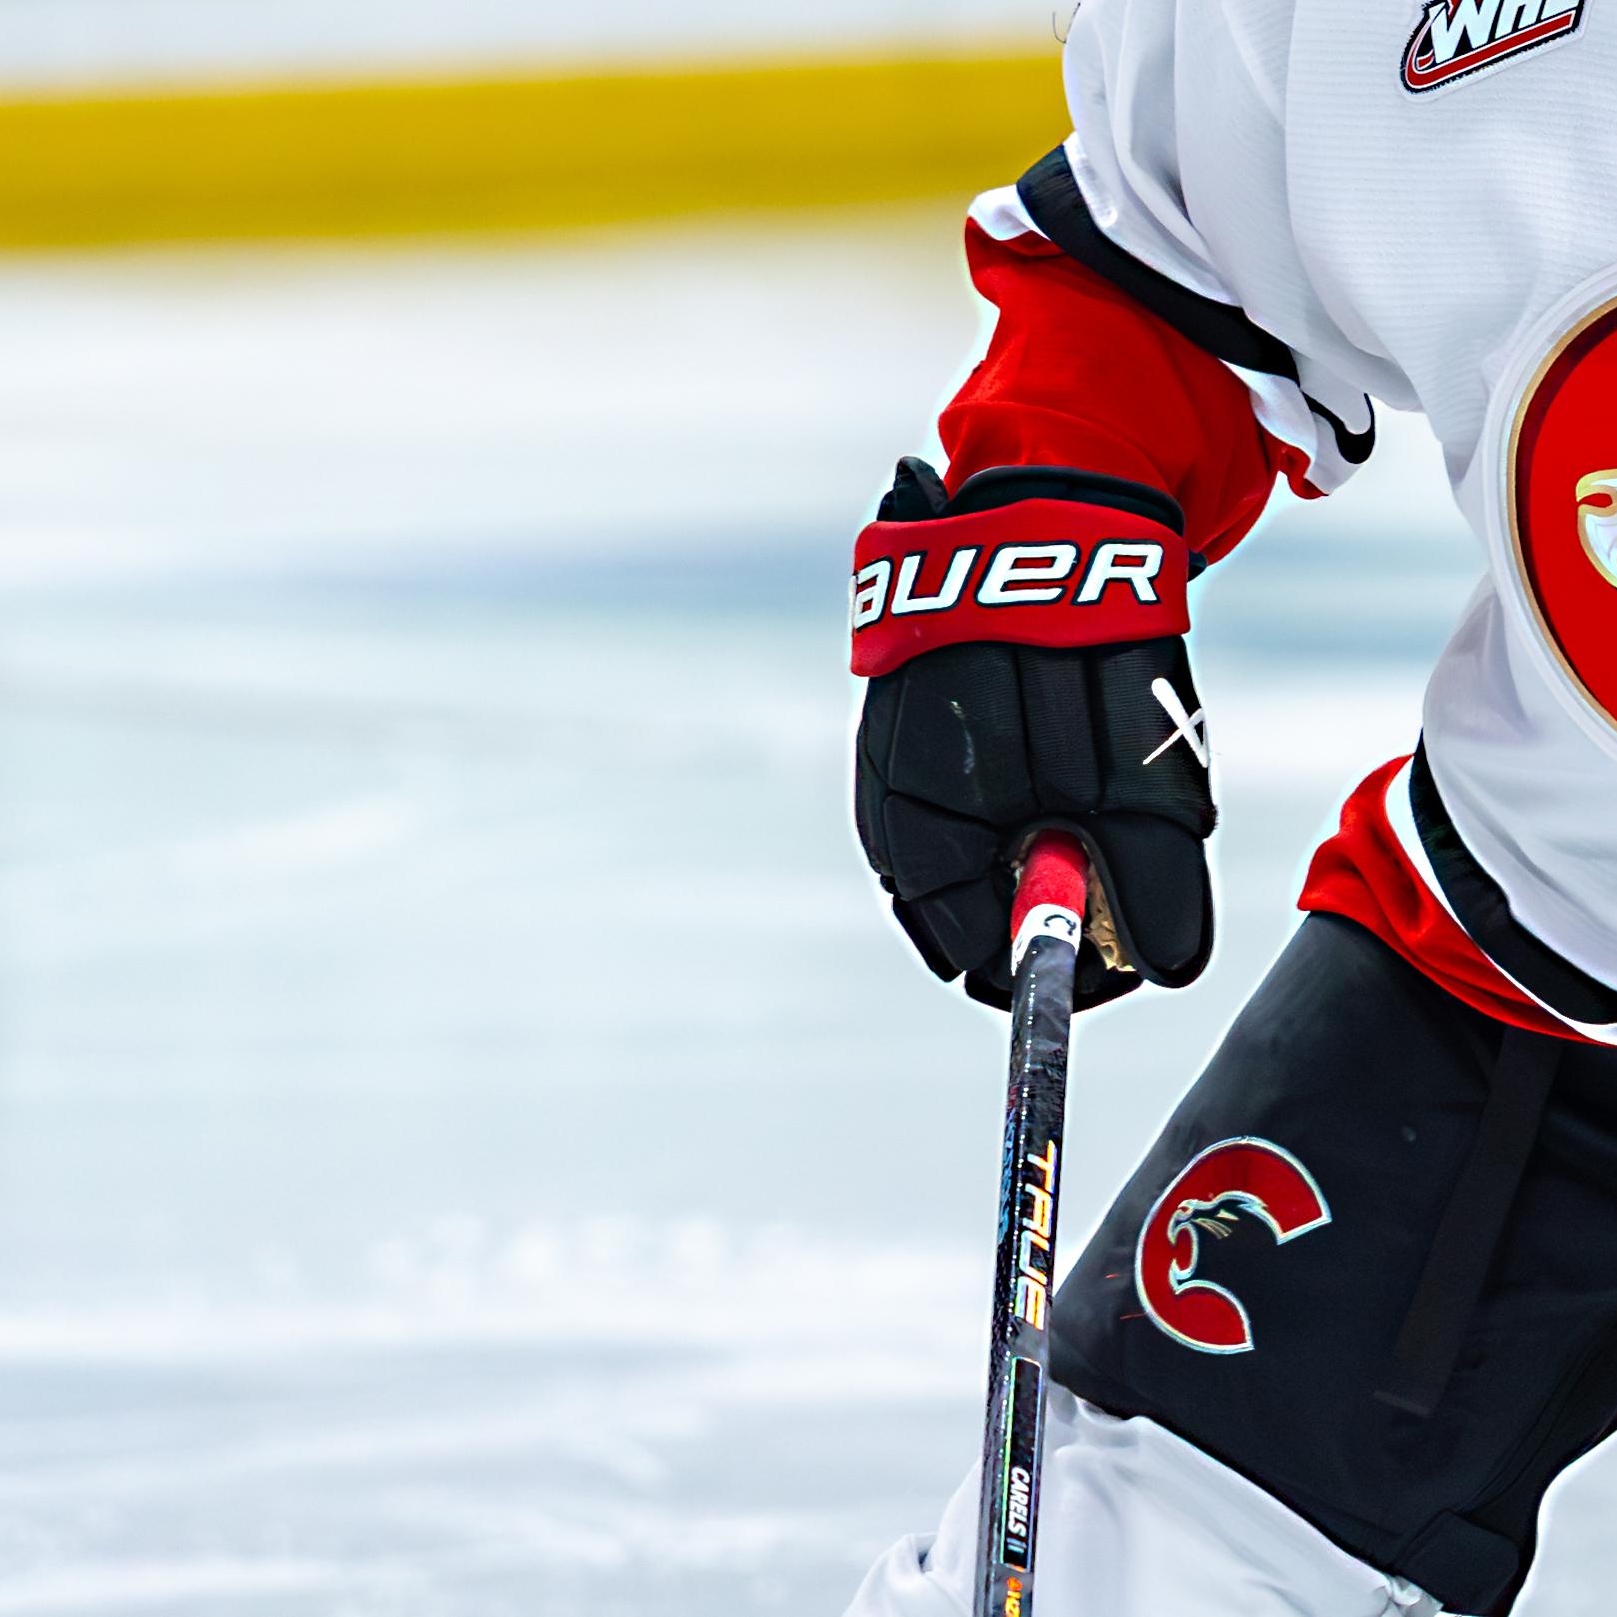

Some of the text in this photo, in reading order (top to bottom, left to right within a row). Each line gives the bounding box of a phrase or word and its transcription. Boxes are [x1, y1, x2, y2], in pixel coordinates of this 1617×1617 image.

[851, 538, 1168, 635] AUER
[1013, 1138, 1058, 1331] TRUE
[1006, 1465, 1031, 1538] CARELS
